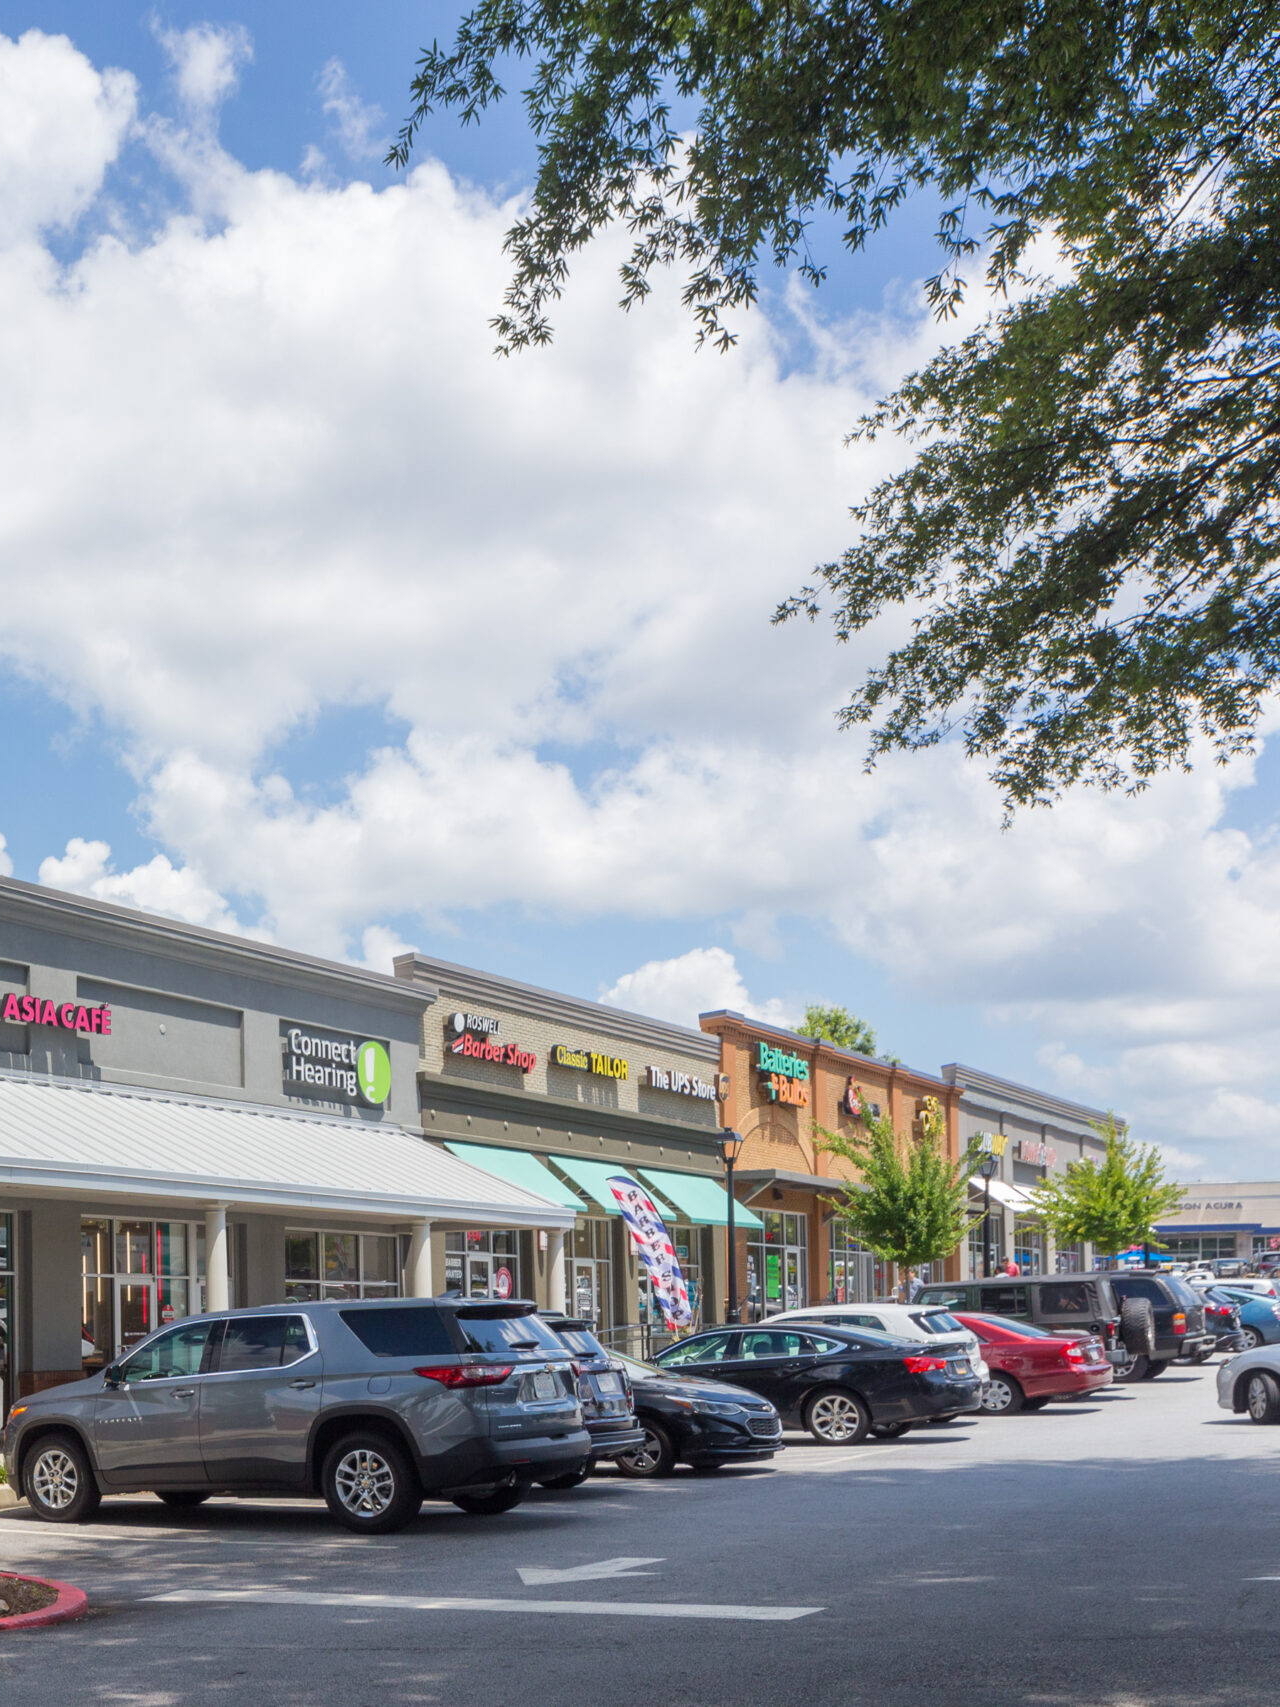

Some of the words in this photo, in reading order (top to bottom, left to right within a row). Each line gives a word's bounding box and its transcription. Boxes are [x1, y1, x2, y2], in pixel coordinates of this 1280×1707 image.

[1, 993, 56, 1027] ASIA
[60, 1001, 112, 1036] CAFÉ
[466, 1013, 502, 1035] ROSWELL
[289, 1028, 357, 1065] Connect
[463, 1033, 505, 1065] Barber
[506, 1043, 537, 1075] Shop
[556, 1045, 588, 1072] Classic
[591, 1052, 629, 1081] TAILOR
[759, 1041, 809, 1081] Batteries
[291, 1055, 358, 1097] Hearing
[650, 1066, 670, 1090] The
[670, 1070, 691, 1096] UPS
[692, 1076, 717, 1101] Store
[778, 1074, 809, 1108] Bulbs
[1205, 1201, 1244, 1210] ACURA
[626, 1190, 665, 1266] BARBER
